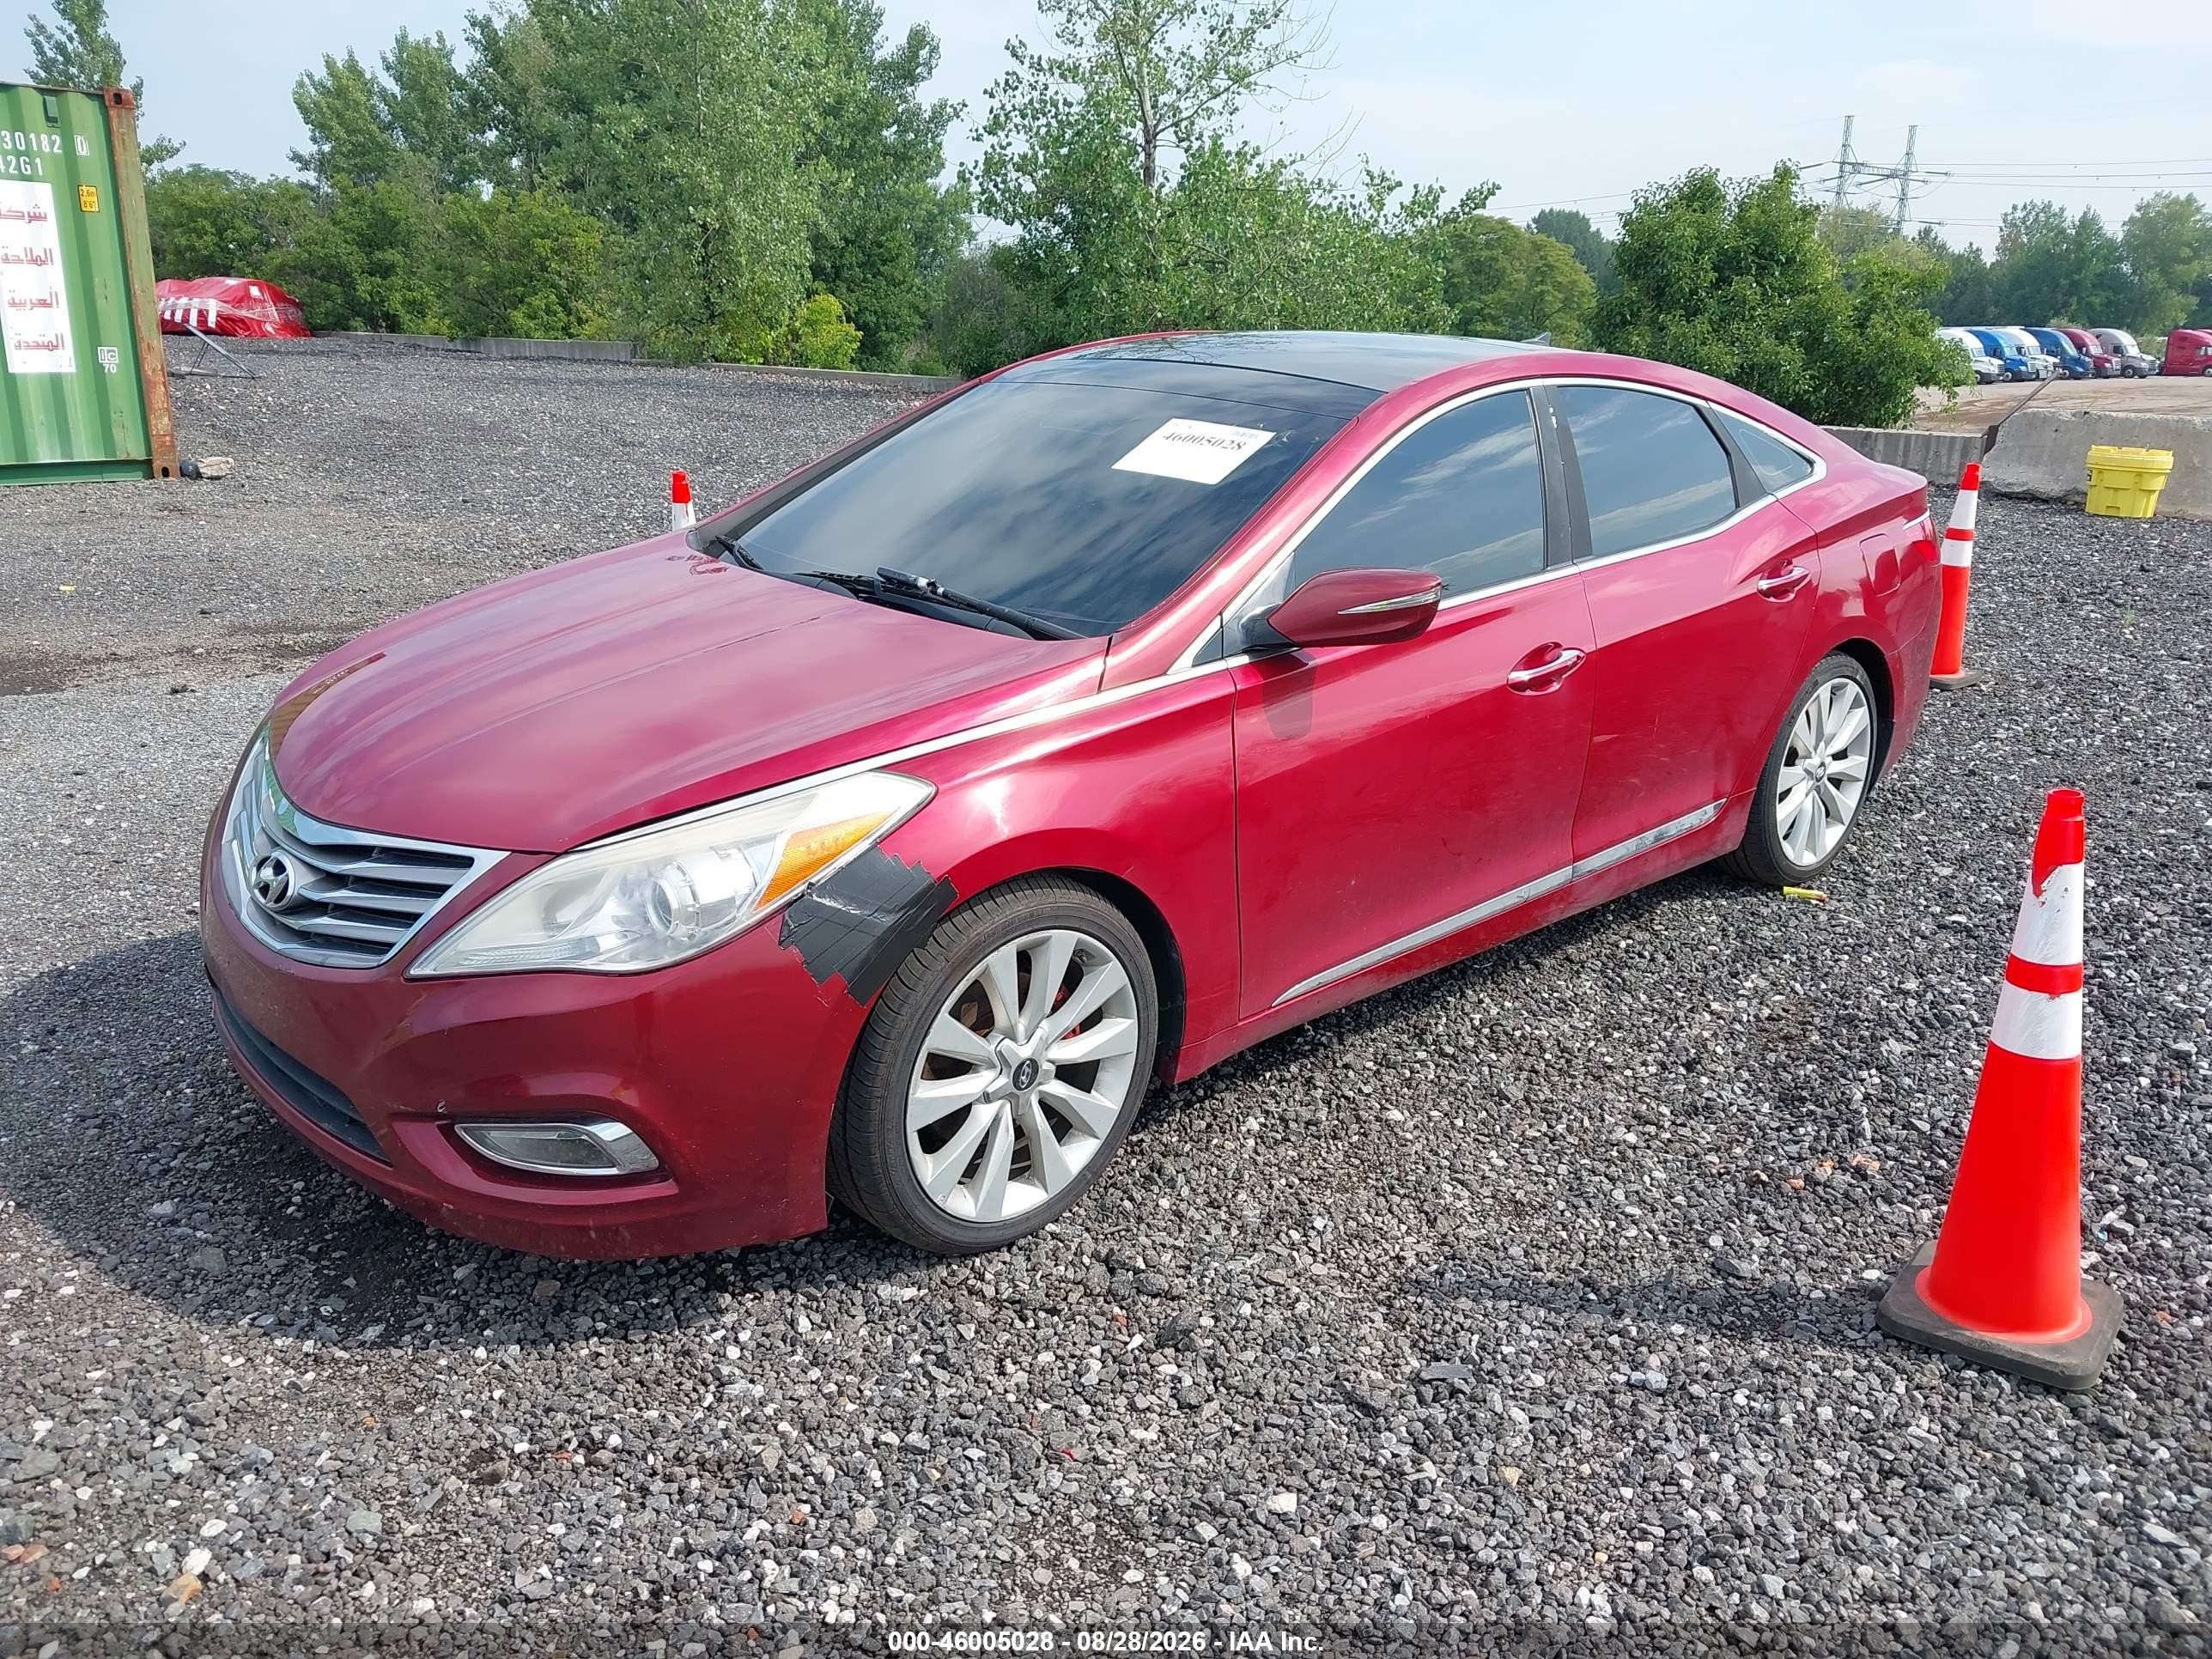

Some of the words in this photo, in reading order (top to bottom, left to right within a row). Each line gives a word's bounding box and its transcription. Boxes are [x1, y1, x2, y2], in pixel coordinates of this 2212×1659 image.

[0, 203, 48, 223] شرك
[1, 246, 54, 266] الملاحة
[7, 289, 59, 310] العربية
[14, 332, 65, 351] المتحدة
[102, 363, 117, 373] 70
[1163, 431, 1247, 451] 46005028
